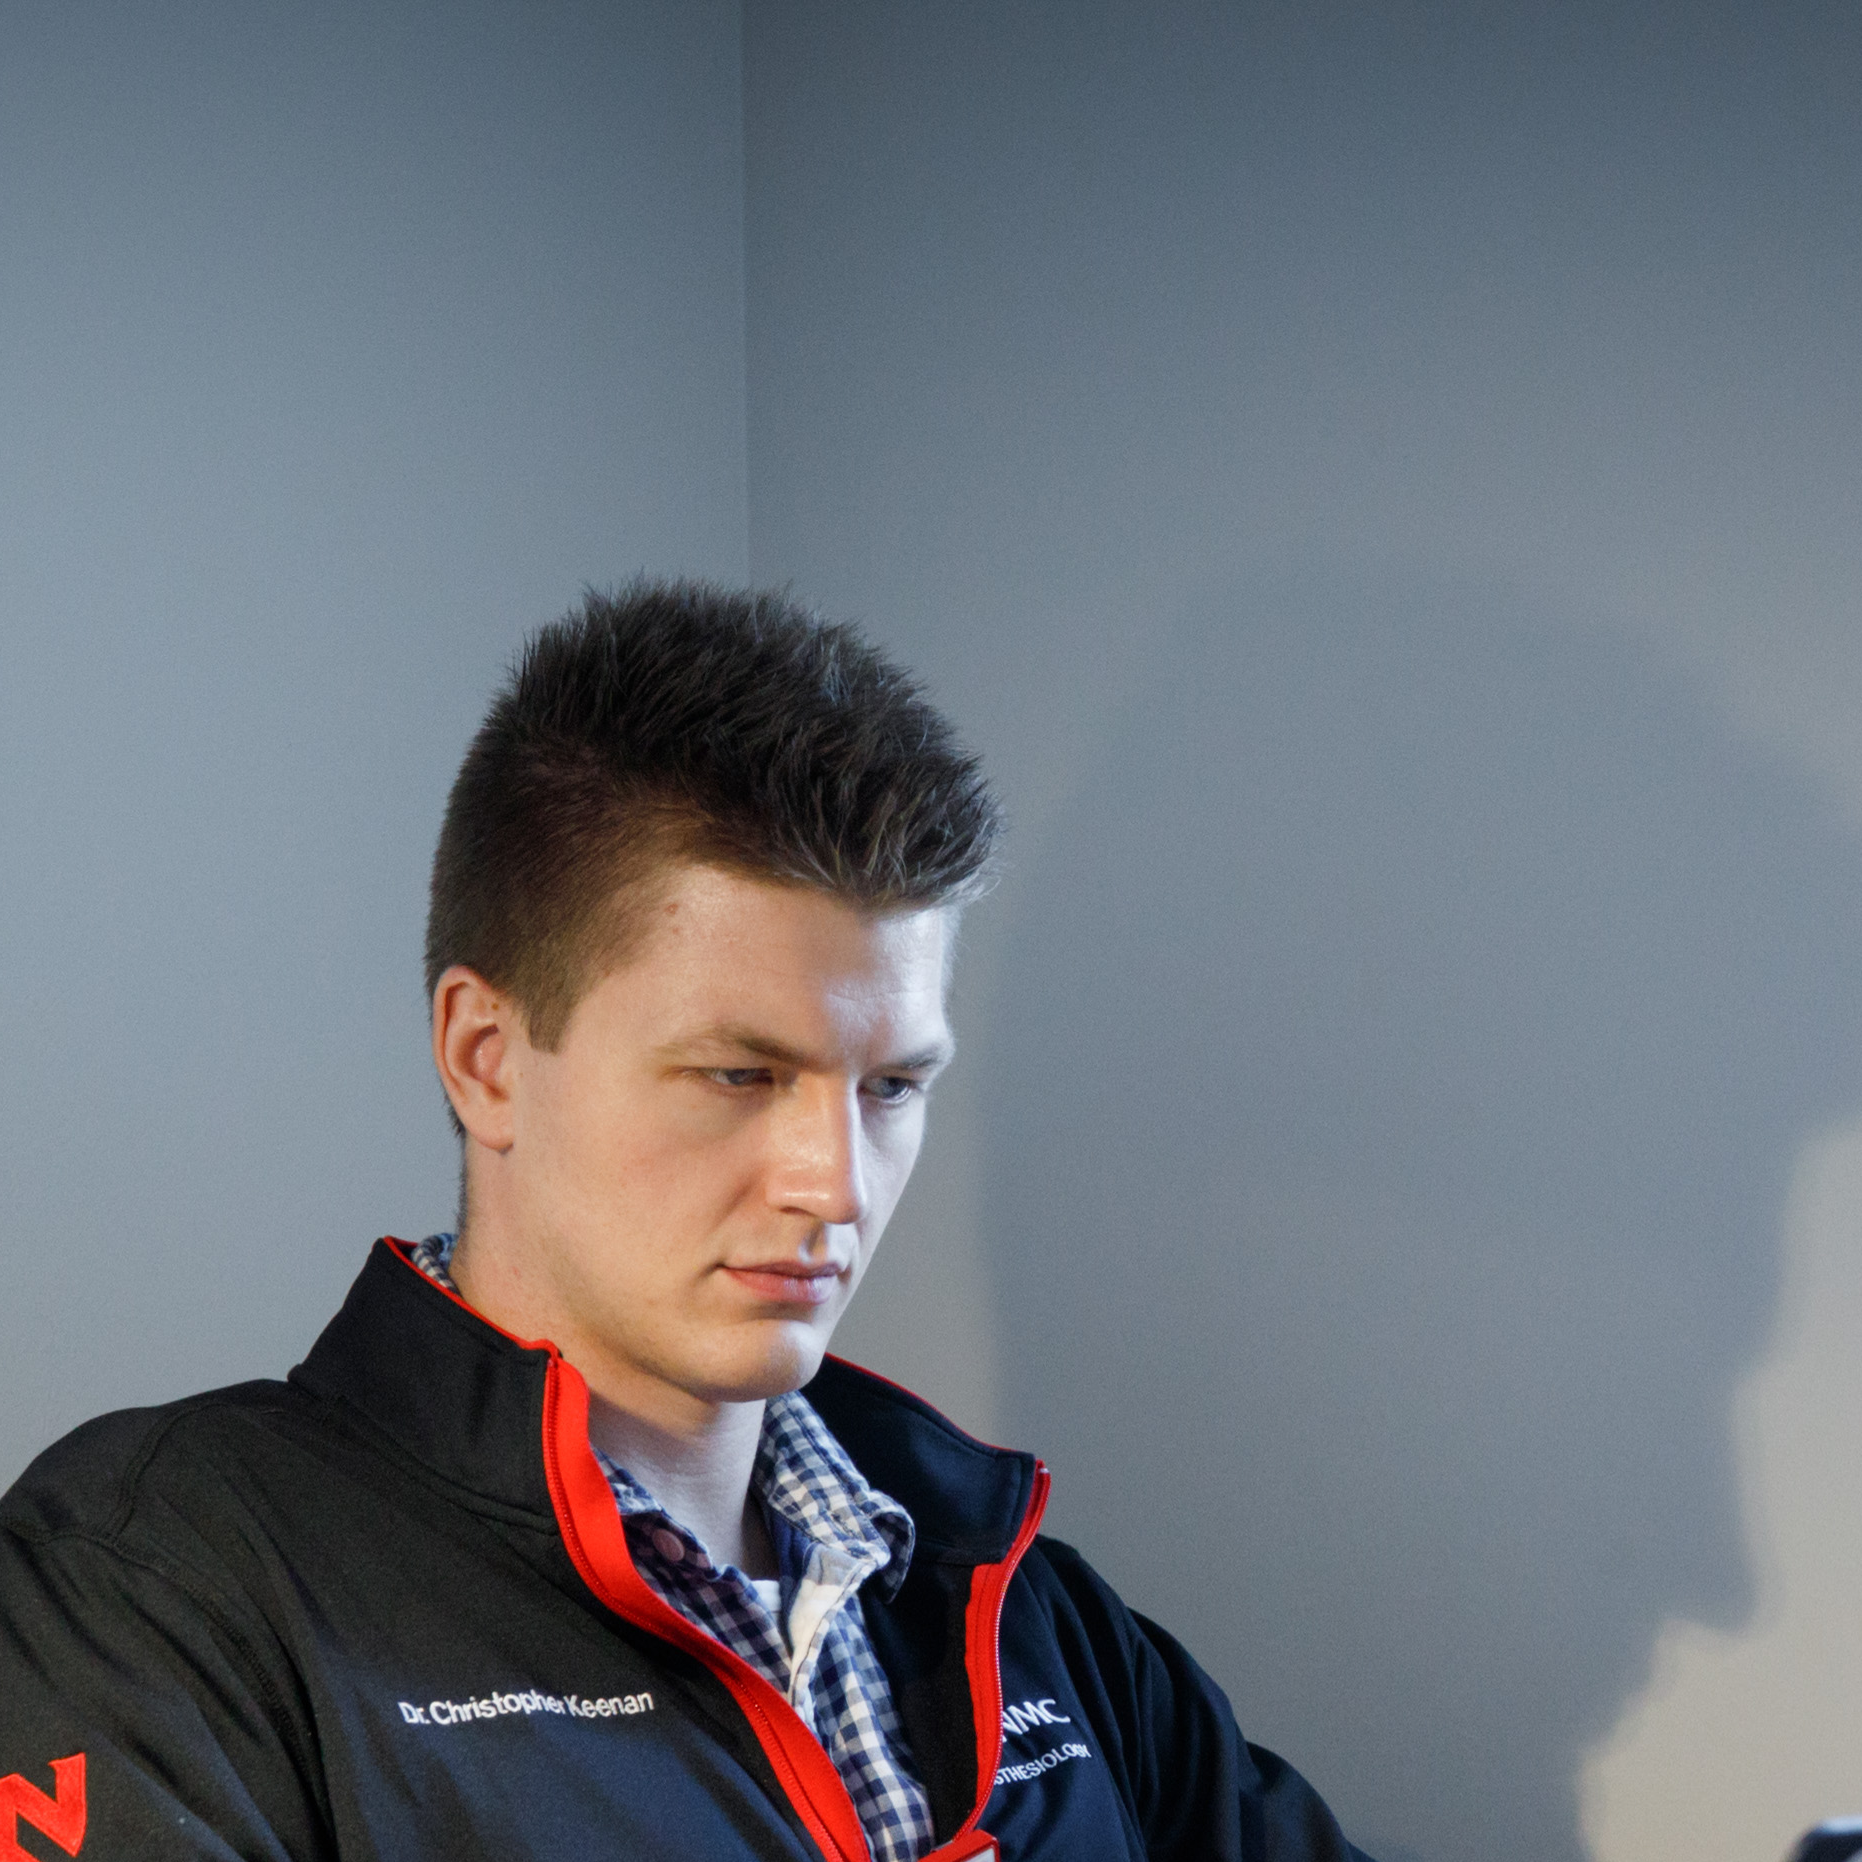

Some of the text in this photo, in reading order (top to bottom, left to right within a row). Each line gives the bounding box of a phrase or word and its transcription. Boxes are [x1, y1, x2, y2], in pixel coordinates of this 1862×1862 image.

[398, 1689, 654, 1725] Dr. Christopher Keenan
